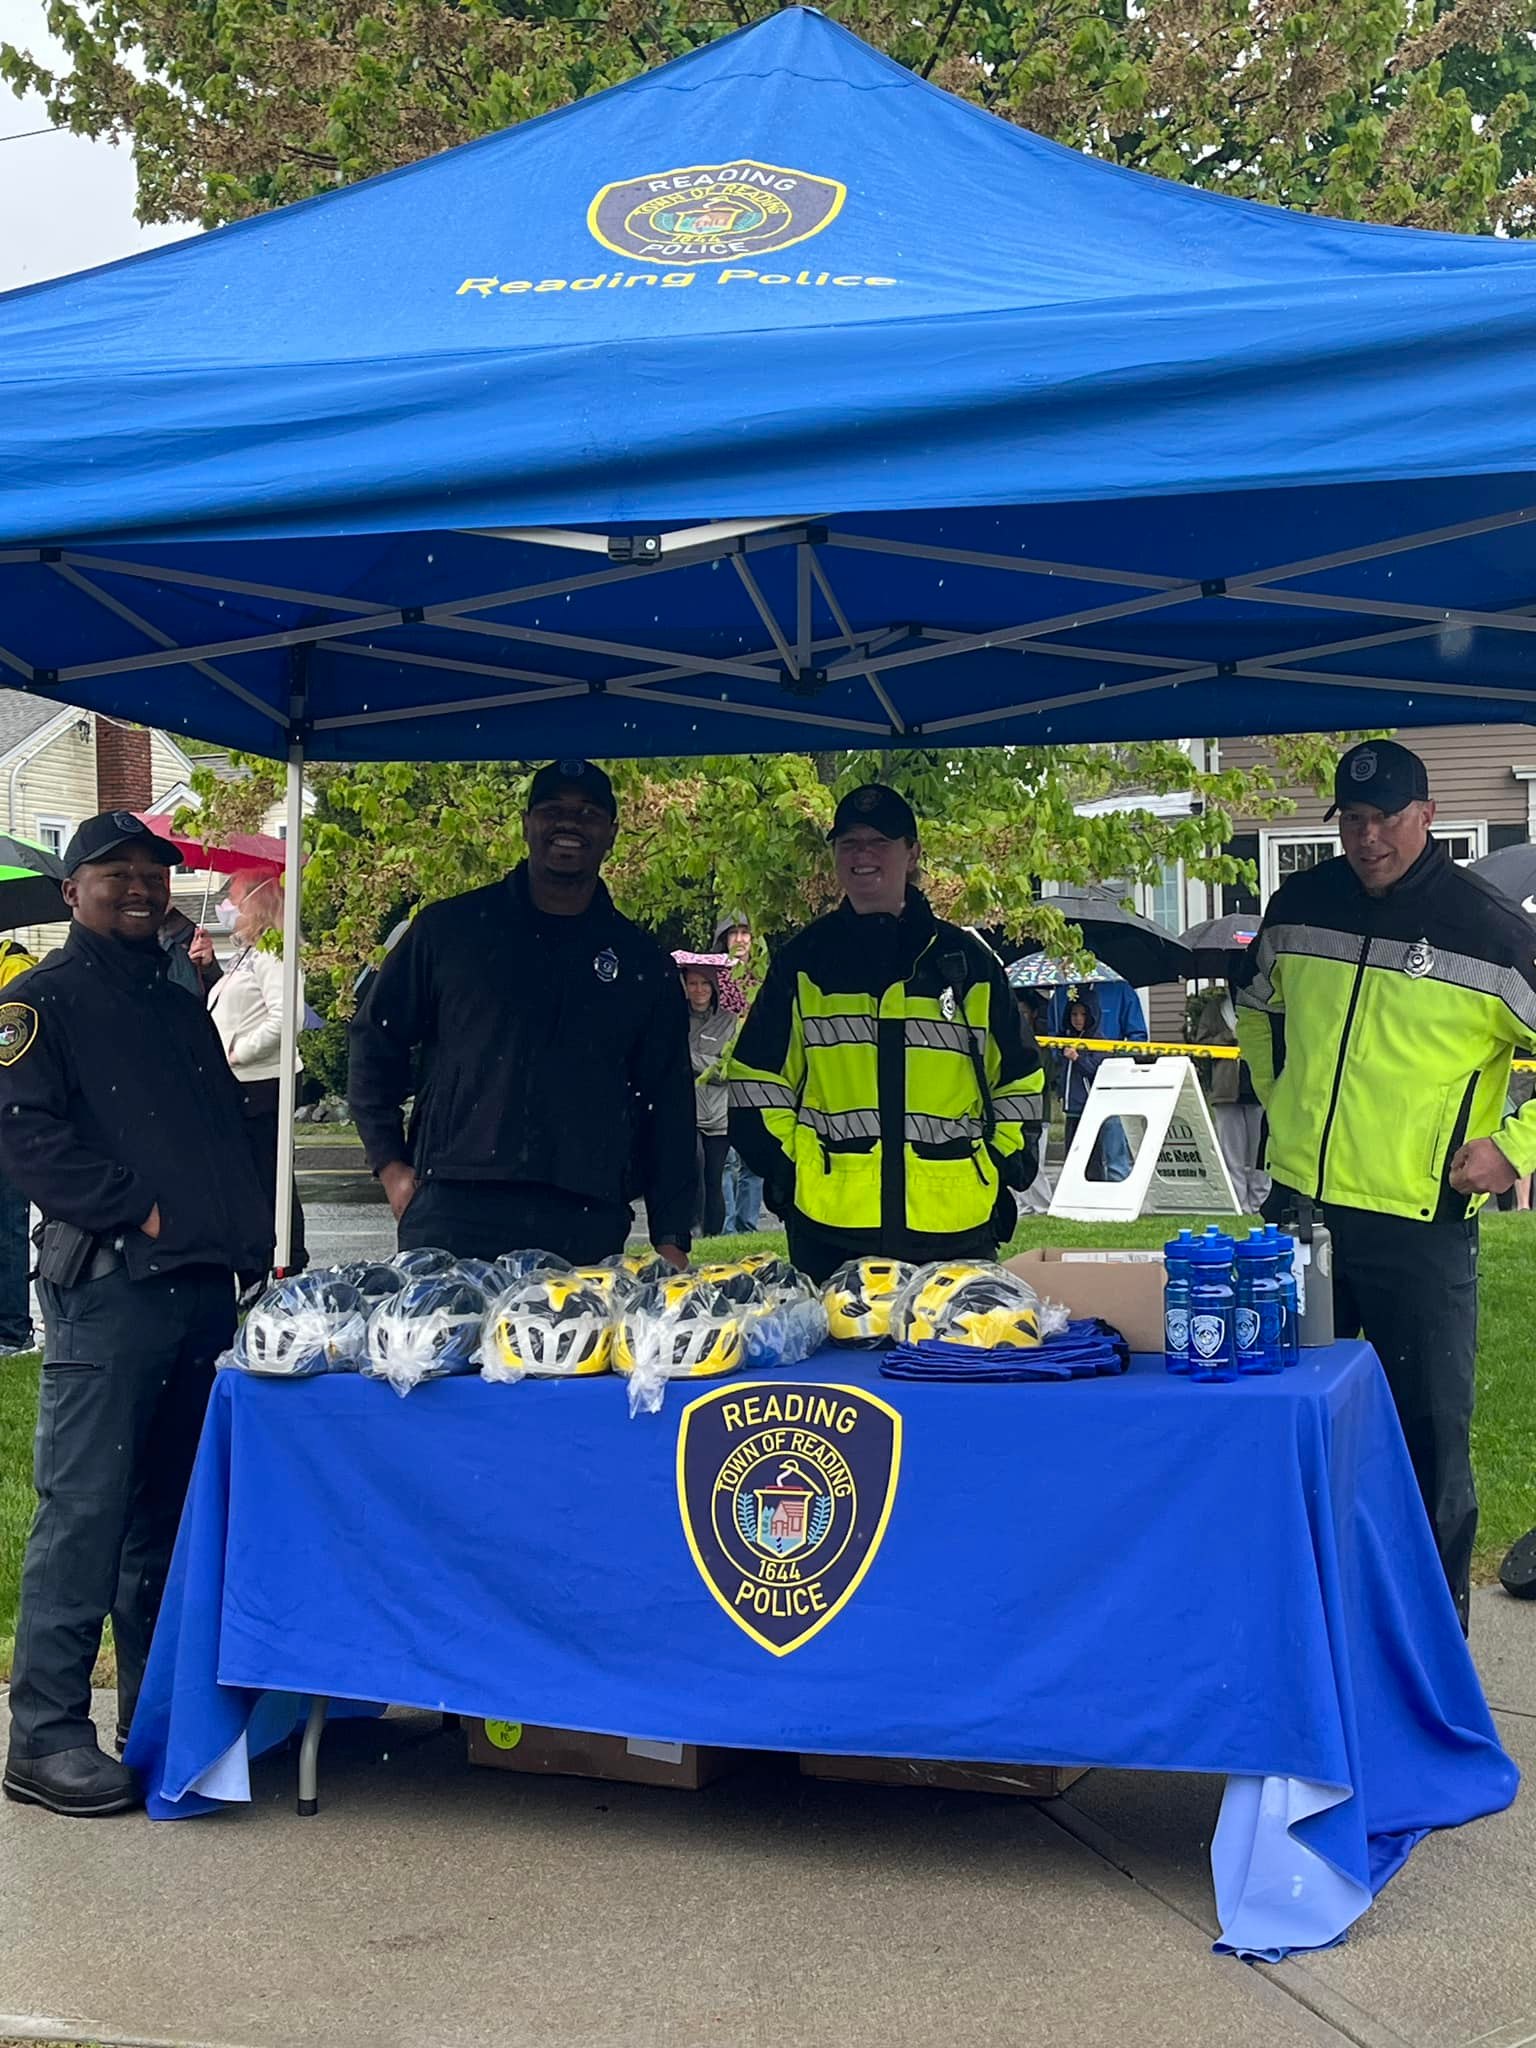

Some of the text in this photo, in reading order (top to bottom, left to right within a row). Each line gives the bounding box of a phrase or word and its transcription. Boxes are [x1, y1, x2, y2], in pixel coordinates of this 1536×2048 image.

[648, 167, 798, 192] READING
[639, 242, 750, 256] POLICE
[455, 268, 898, 296] Reading Police
[721, 1393, 858, 1434] READING
[717, 1432, 851, 1499] TOWN OF READING
[758, 1559, 802, 1582] 1644
[734, 1580, 828, 1617] POLICE
